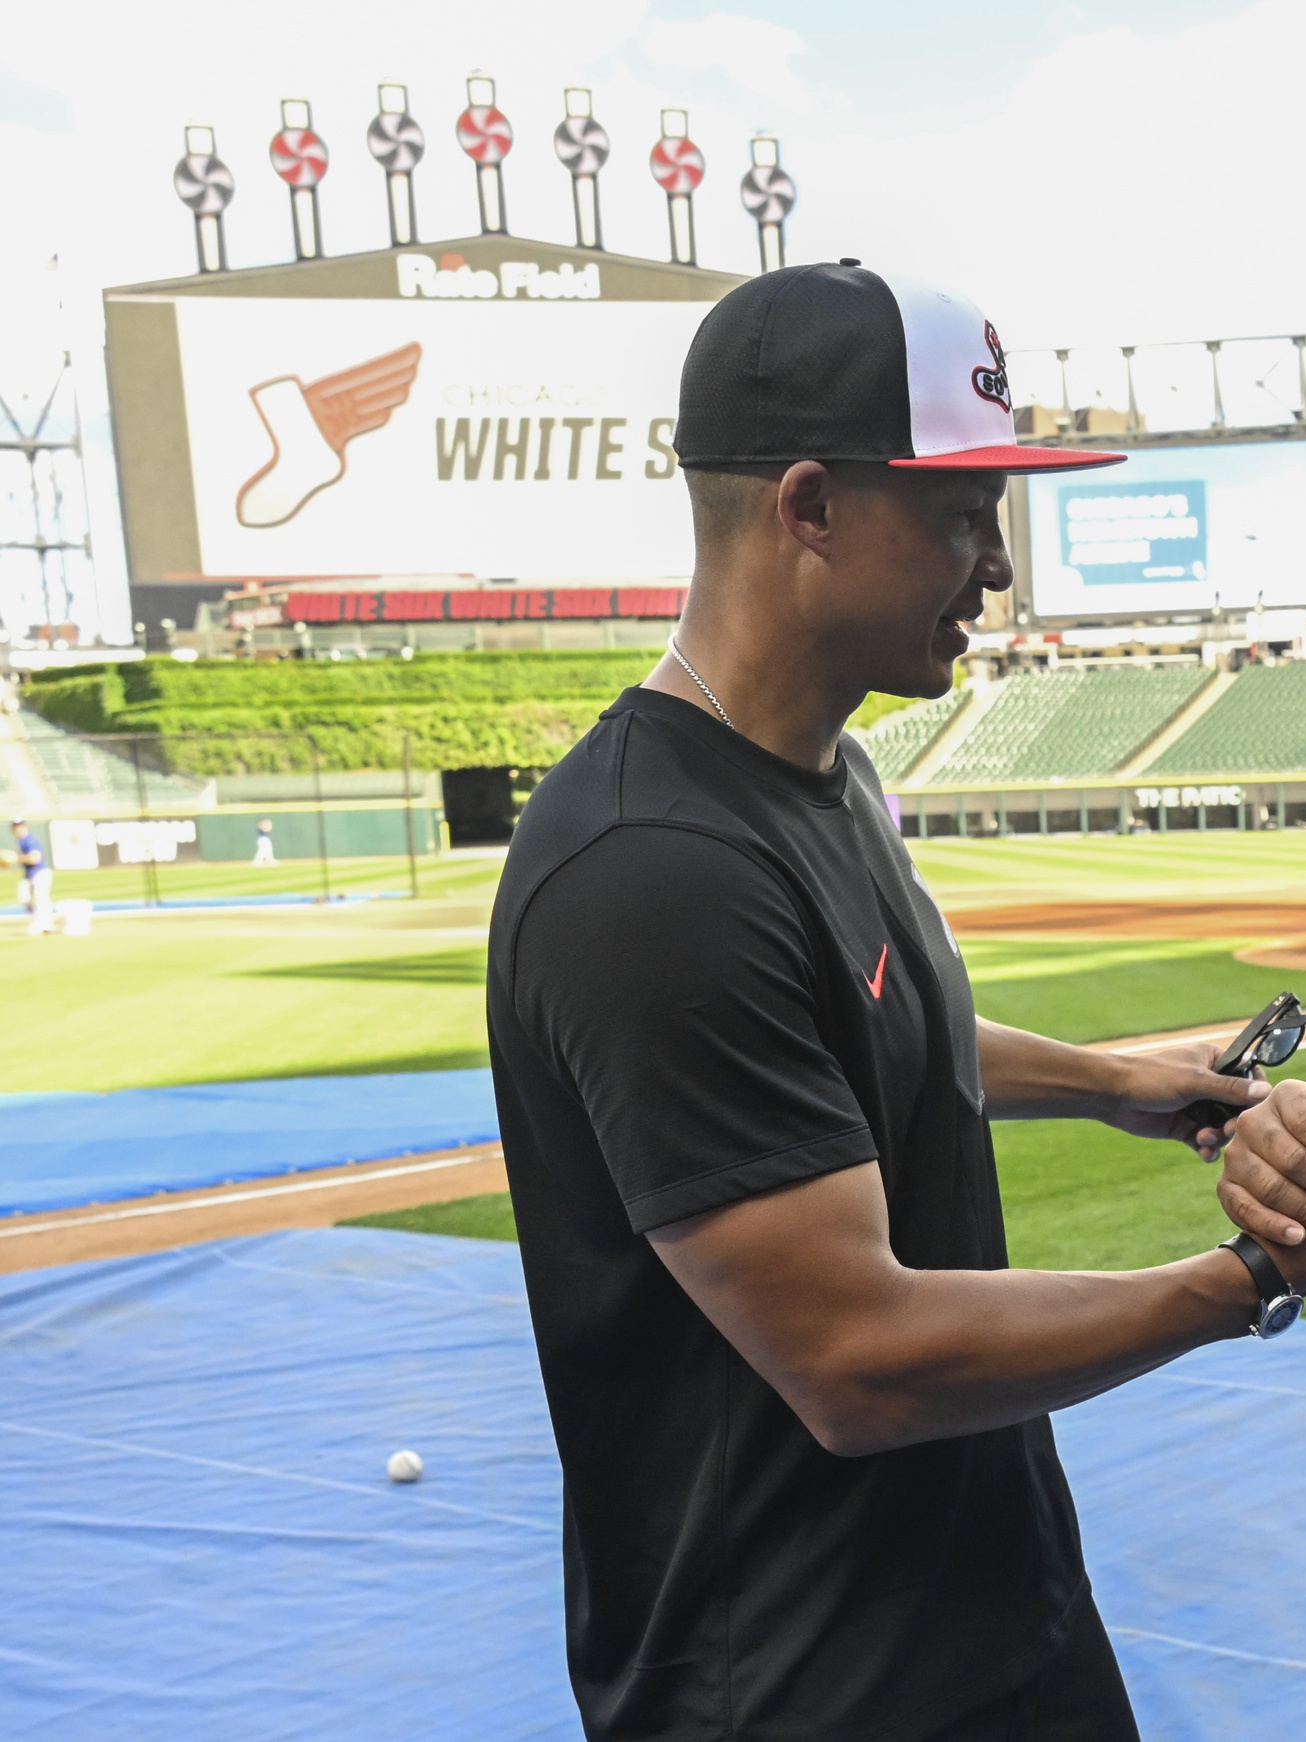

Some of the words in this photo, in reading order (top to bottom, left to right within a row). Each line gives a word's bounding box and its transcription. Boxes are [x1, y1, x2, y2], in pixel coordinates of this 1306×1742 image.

[396, 253, 499, 298] Rate
[500, 262, 600, 298] Field
[436, 417, 627, 481] WHITE
[1135, 787, 1180, 808] THE
